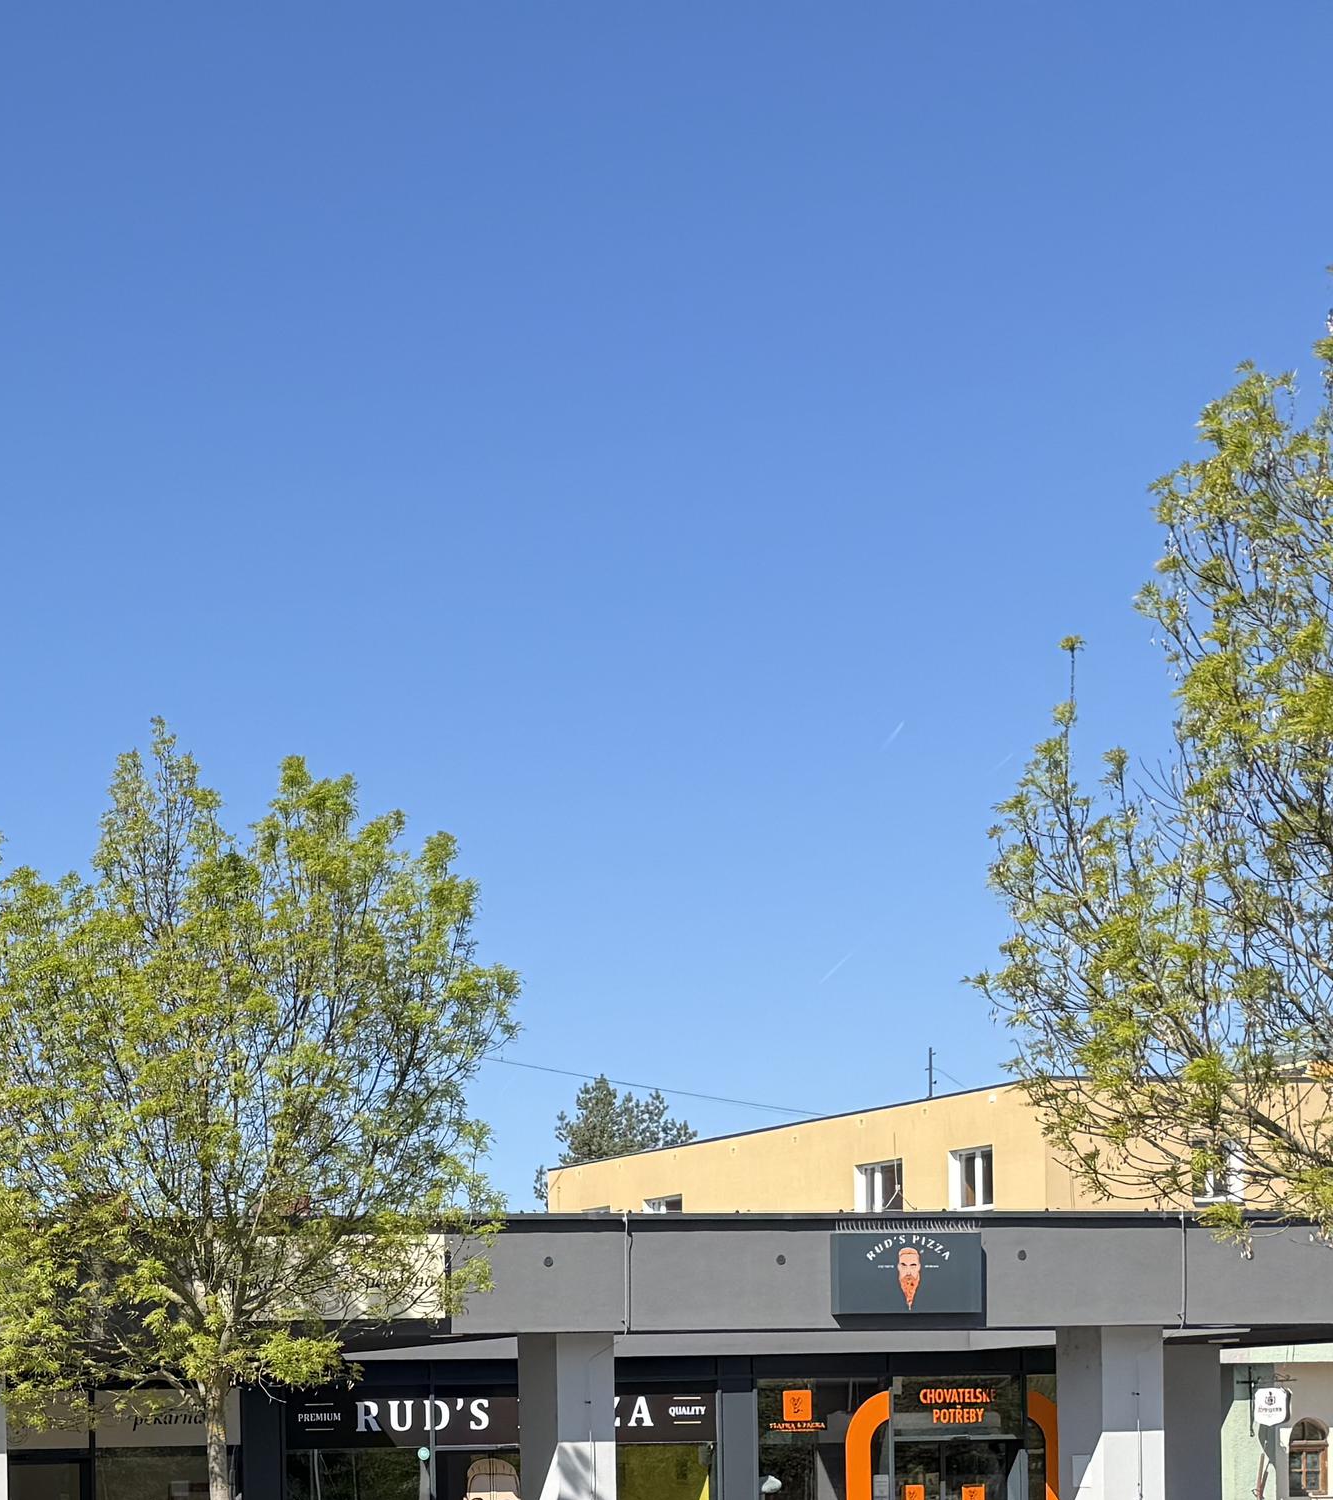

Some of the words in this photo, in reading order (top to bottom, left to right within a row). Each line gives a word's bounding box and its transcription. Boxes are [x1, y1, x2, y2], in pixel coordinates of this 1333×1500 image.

[912, 1234, 951, 1261] PIZZA
[297, 1412, 341, 1422] PREMIUM
[668, 1405, 706, 1417] QUALITY
[932, 1405, 985, 1424] POTŘEBY
